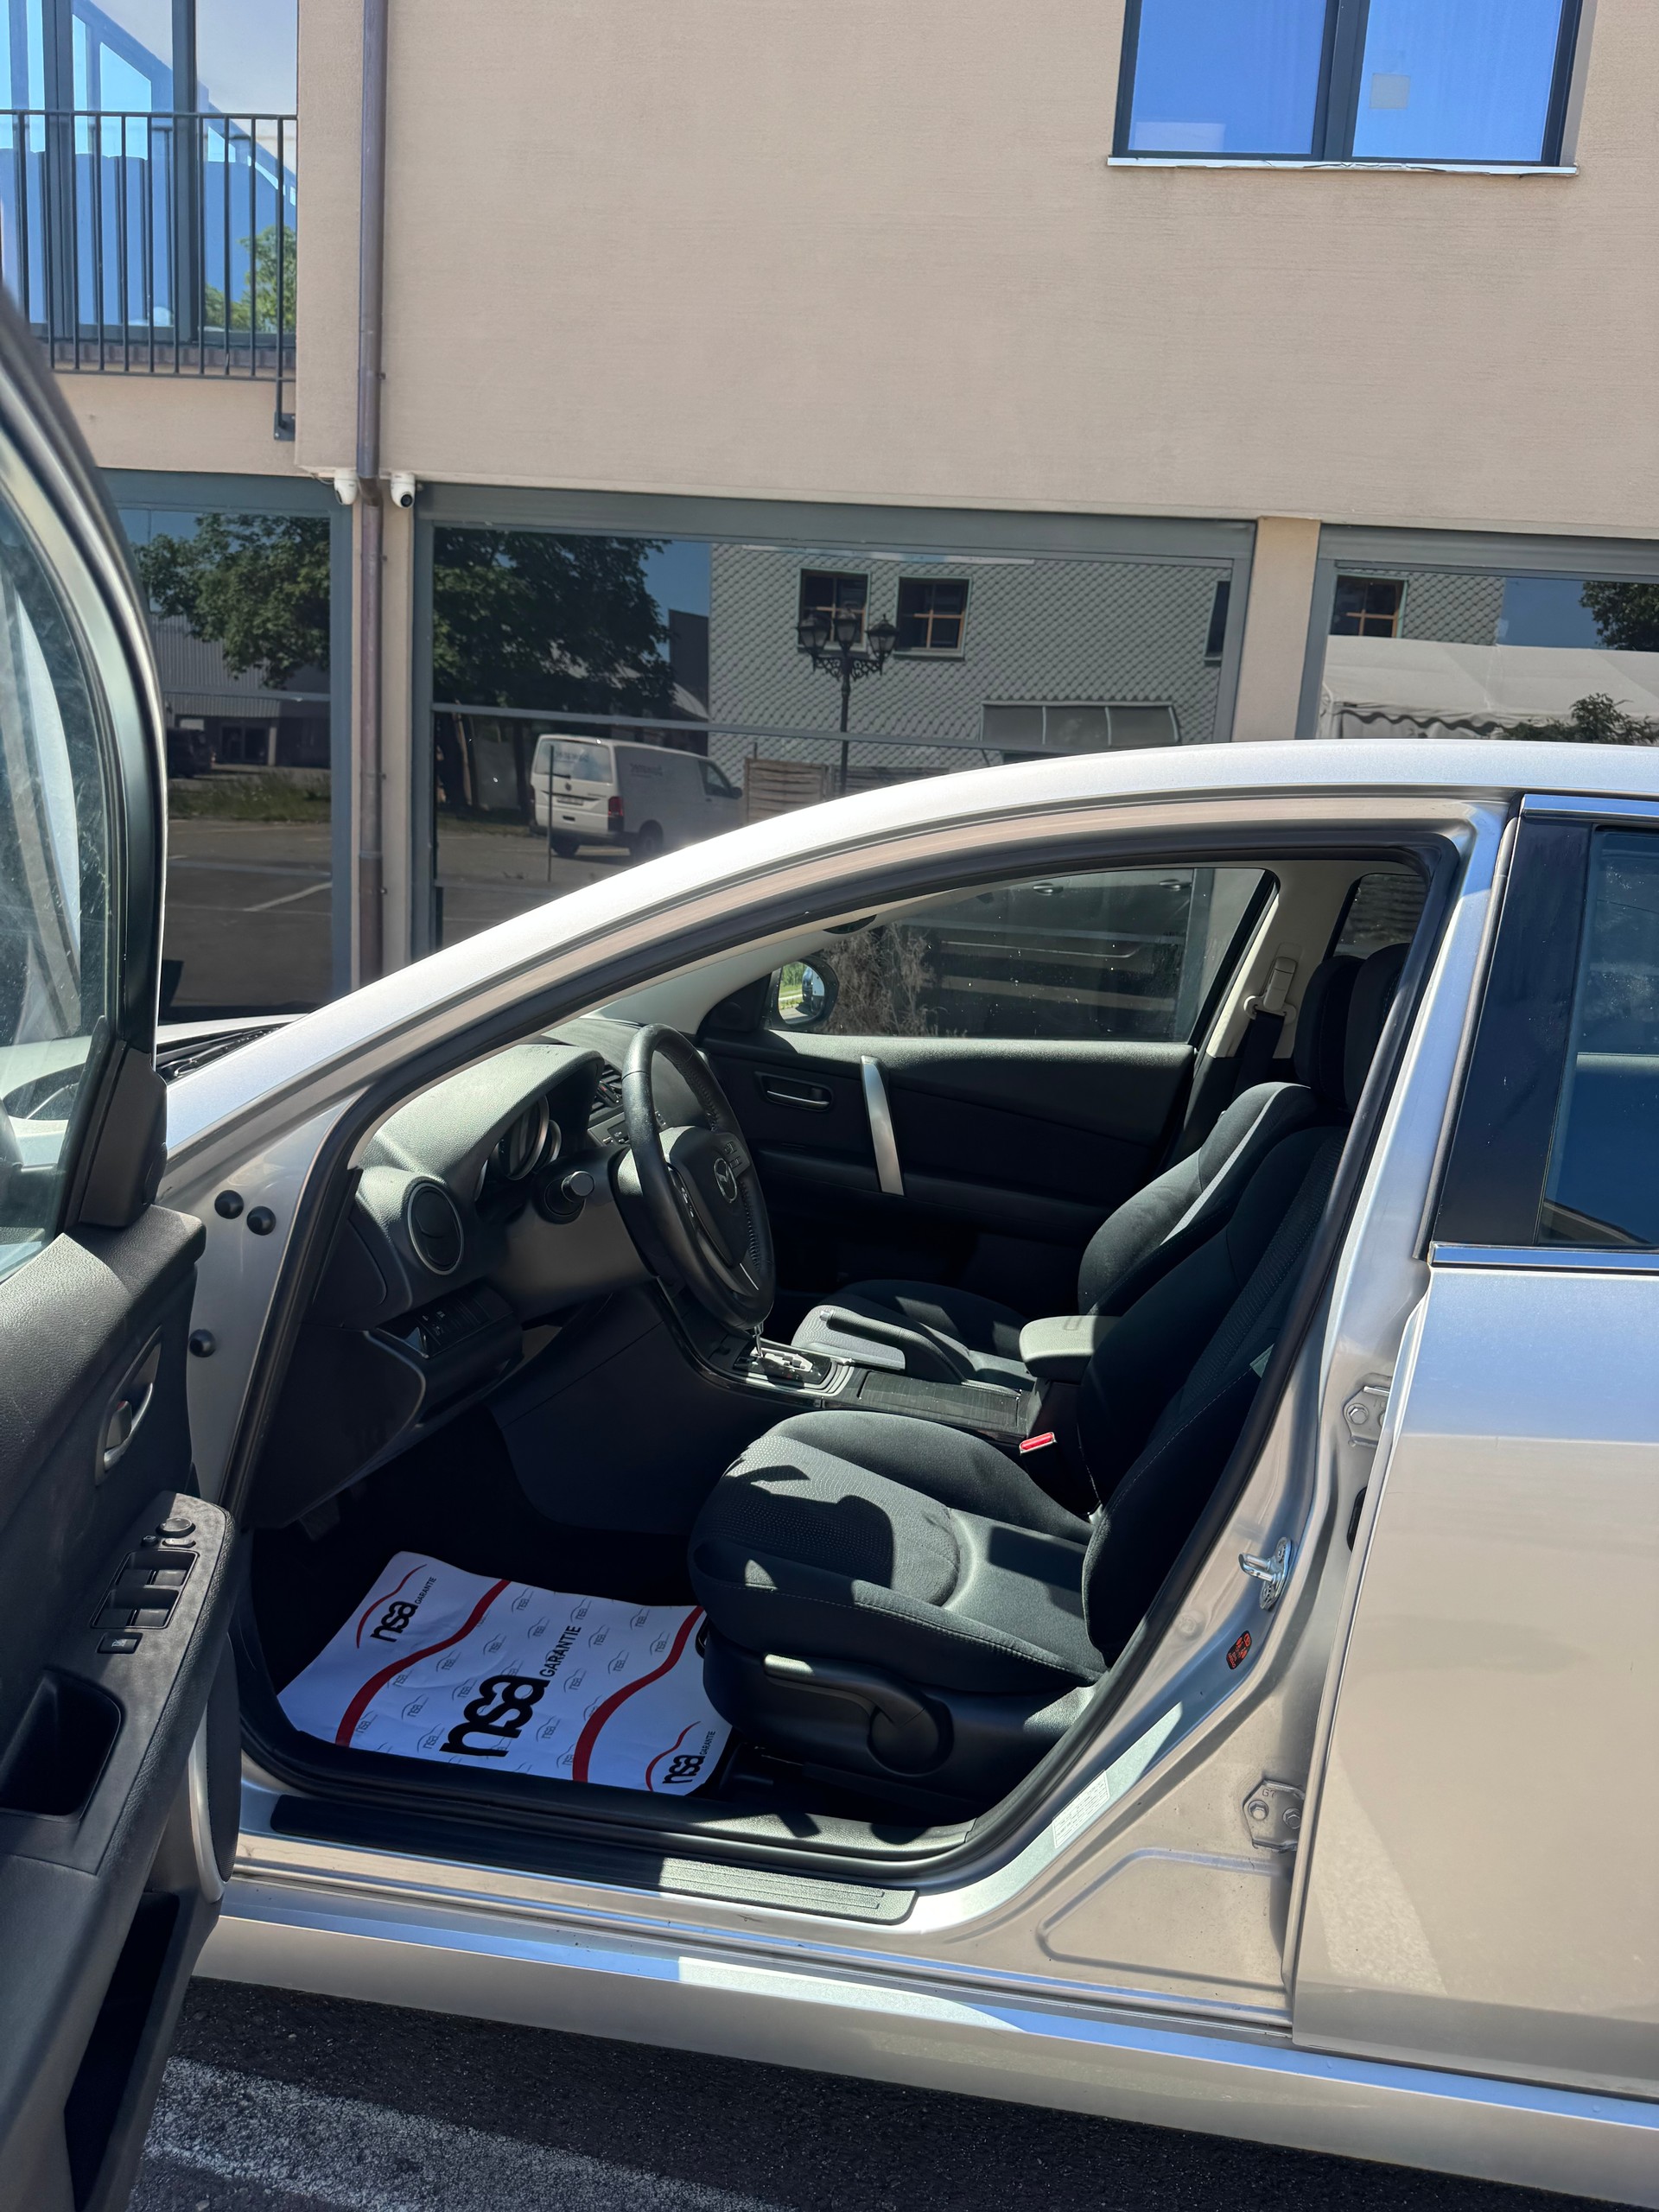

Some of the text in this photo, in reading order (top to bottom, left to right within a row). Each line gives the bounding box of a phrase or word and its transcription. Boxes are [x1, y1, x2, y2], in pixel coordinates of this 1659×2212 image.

[370, 1576, 437, 1642] nsa GARANTIE
[439, 1625, 582, 1757] nsa GARANTIE
[662, 1731, 715, 1783] nsa GARANTIE
[1262, 1788, 1276, 1797] G7
